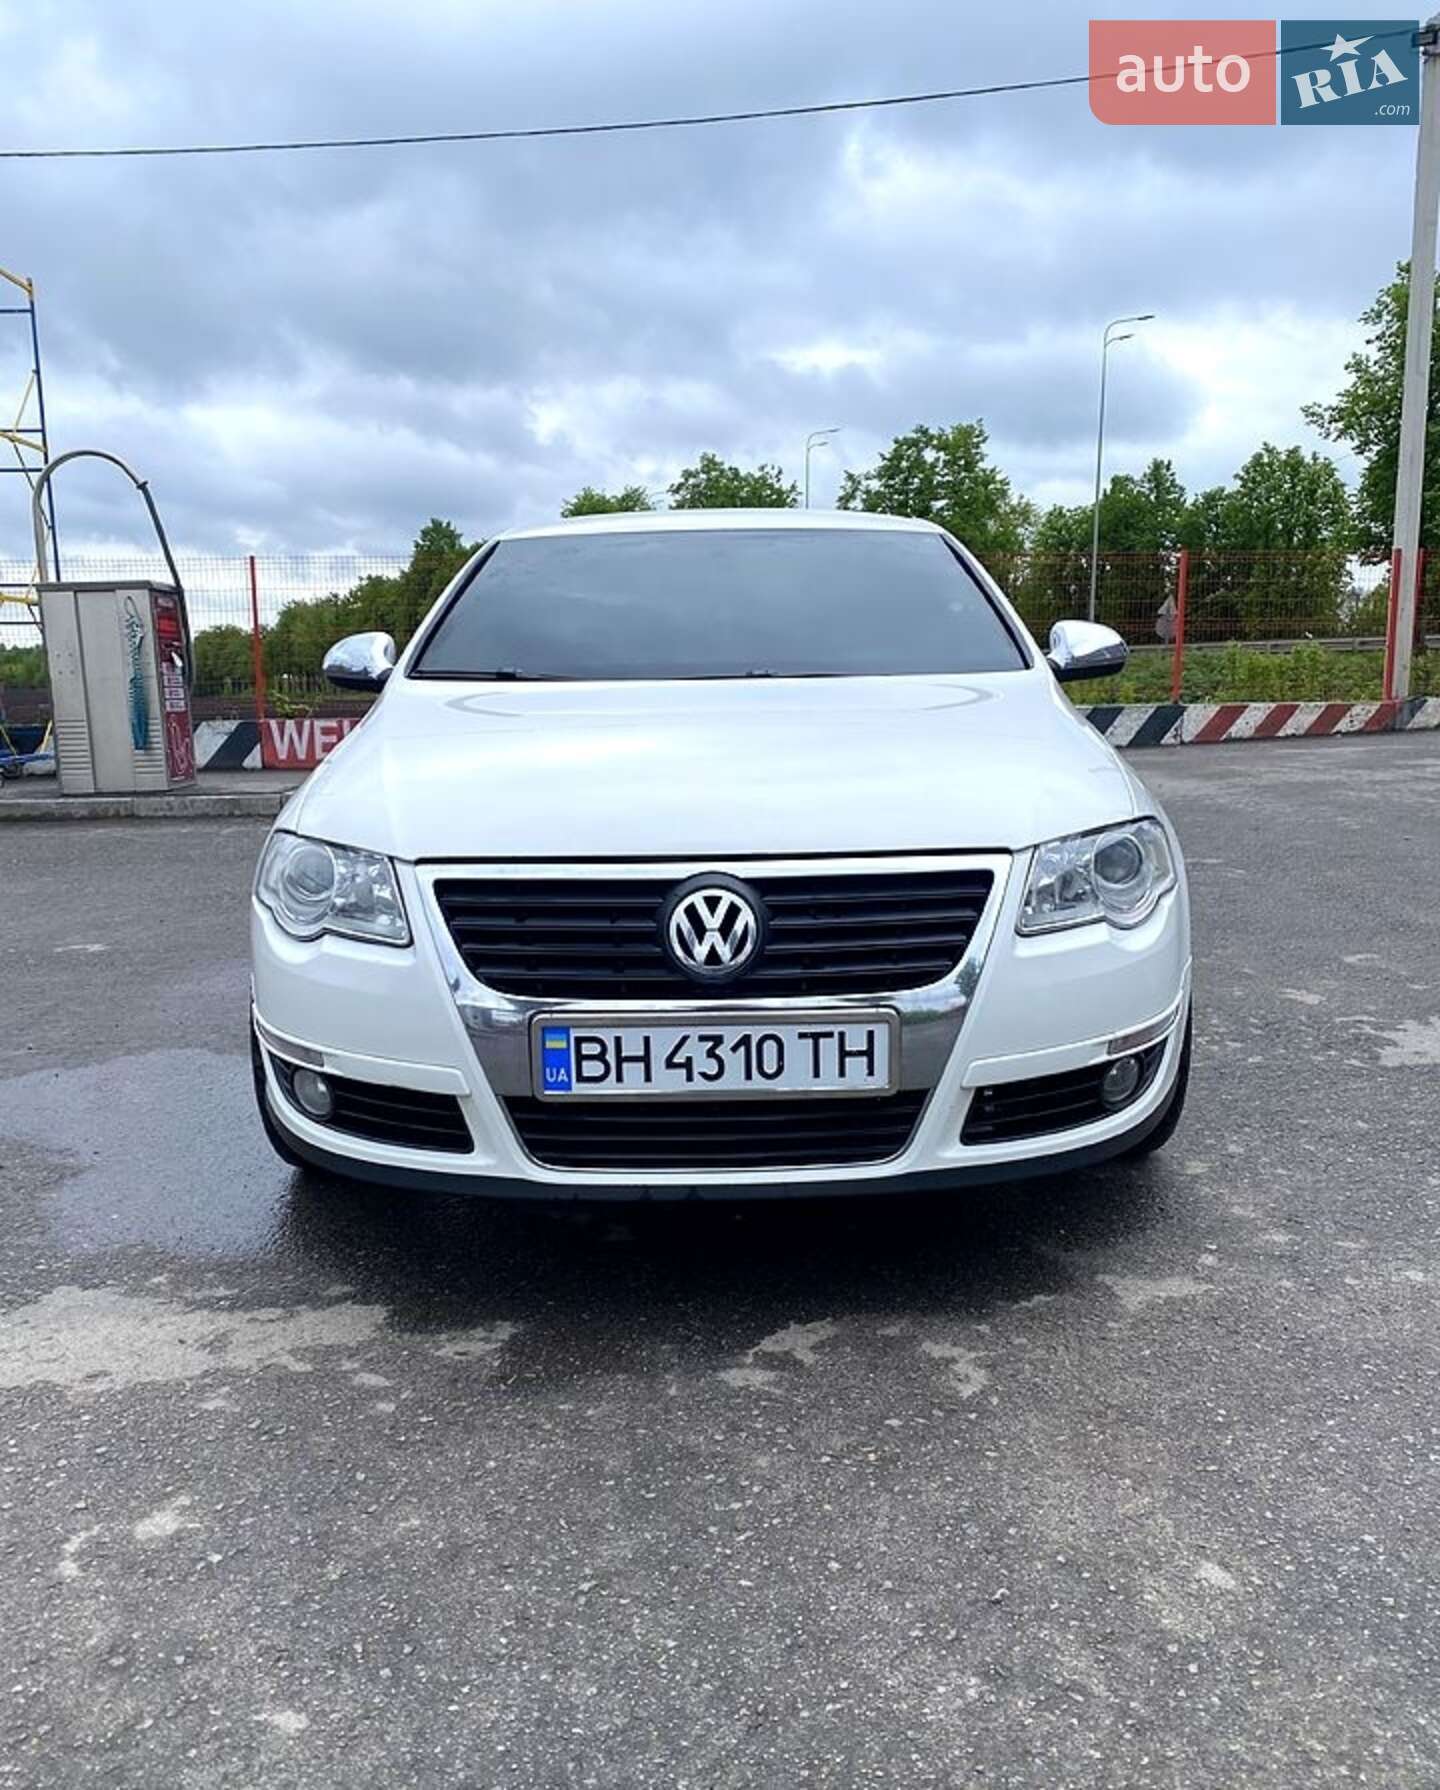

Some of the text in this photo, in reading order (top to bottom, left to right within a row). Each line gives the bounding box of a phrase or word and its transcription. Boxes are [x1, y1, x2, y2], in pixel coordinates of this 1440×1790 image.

[669, 888, 757, 975] VW
[545, 1069, 569, 1083] UA
[574, 1030, 875, 1085] BH 4310 TH
